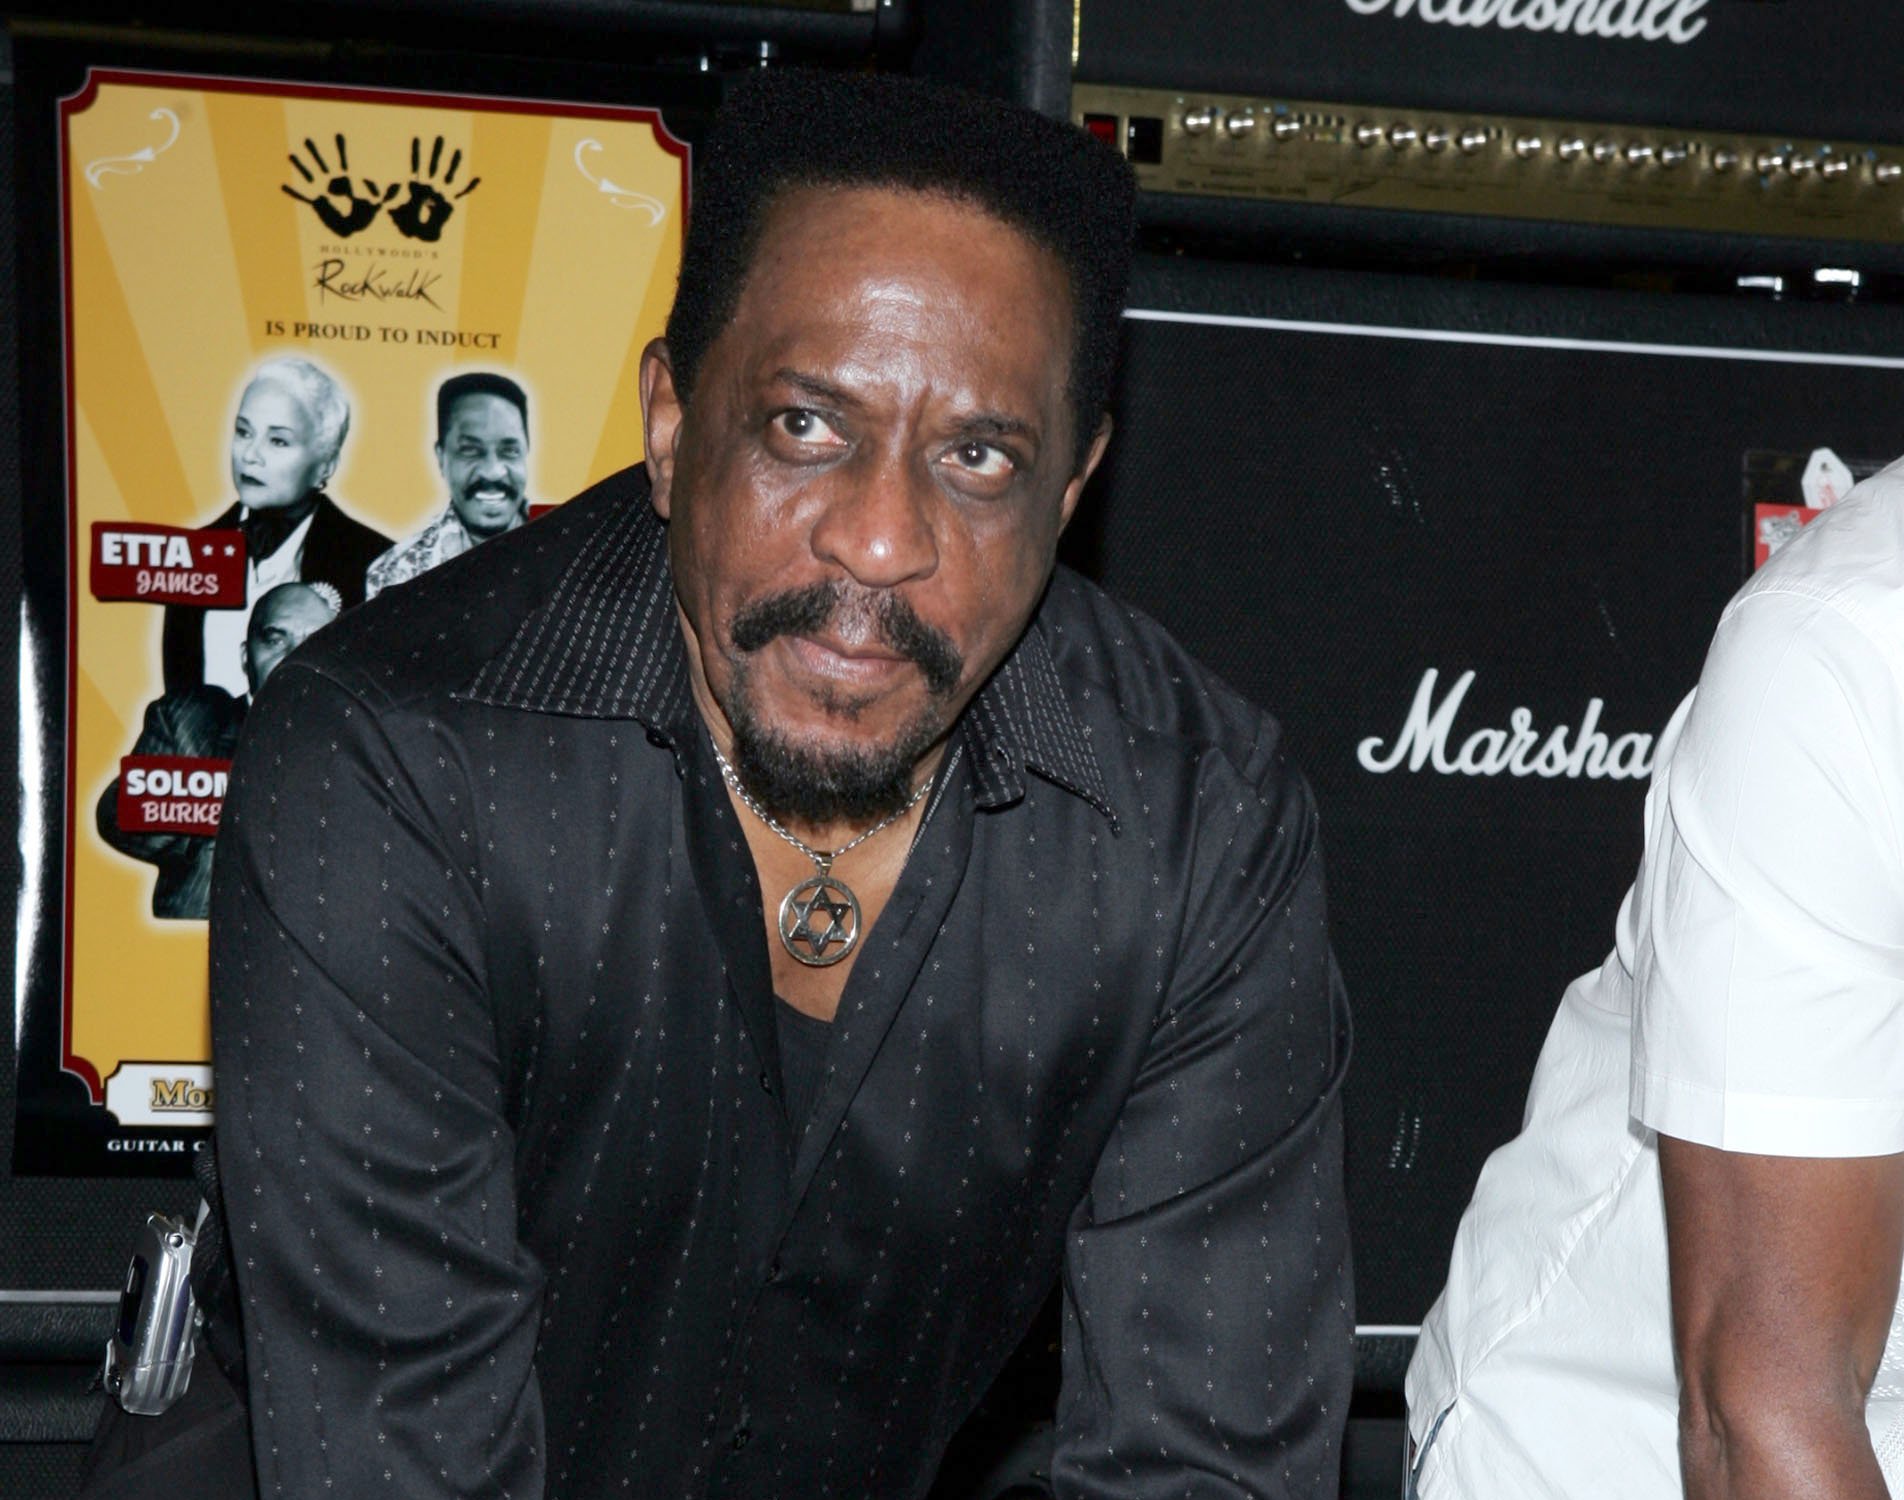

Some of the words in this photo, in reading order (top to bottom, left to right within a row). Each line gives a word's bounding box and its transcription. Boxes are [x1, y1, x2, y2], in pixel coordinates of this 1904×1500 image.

[1345, 0, 1707, 44] asall
[265, 320, 286, 336] IS
[293, 322, 371, 341] PROUD
[379, 327, 408, 343] TO
[417, 329, 502, 349] INDUCT
[101, 532, 194, 568] ETTA
[136, 570, 219, 595] JAMES
[142, 801, 222, 825] BURKE
[107, 1139, 184, 1152] GUITAR
